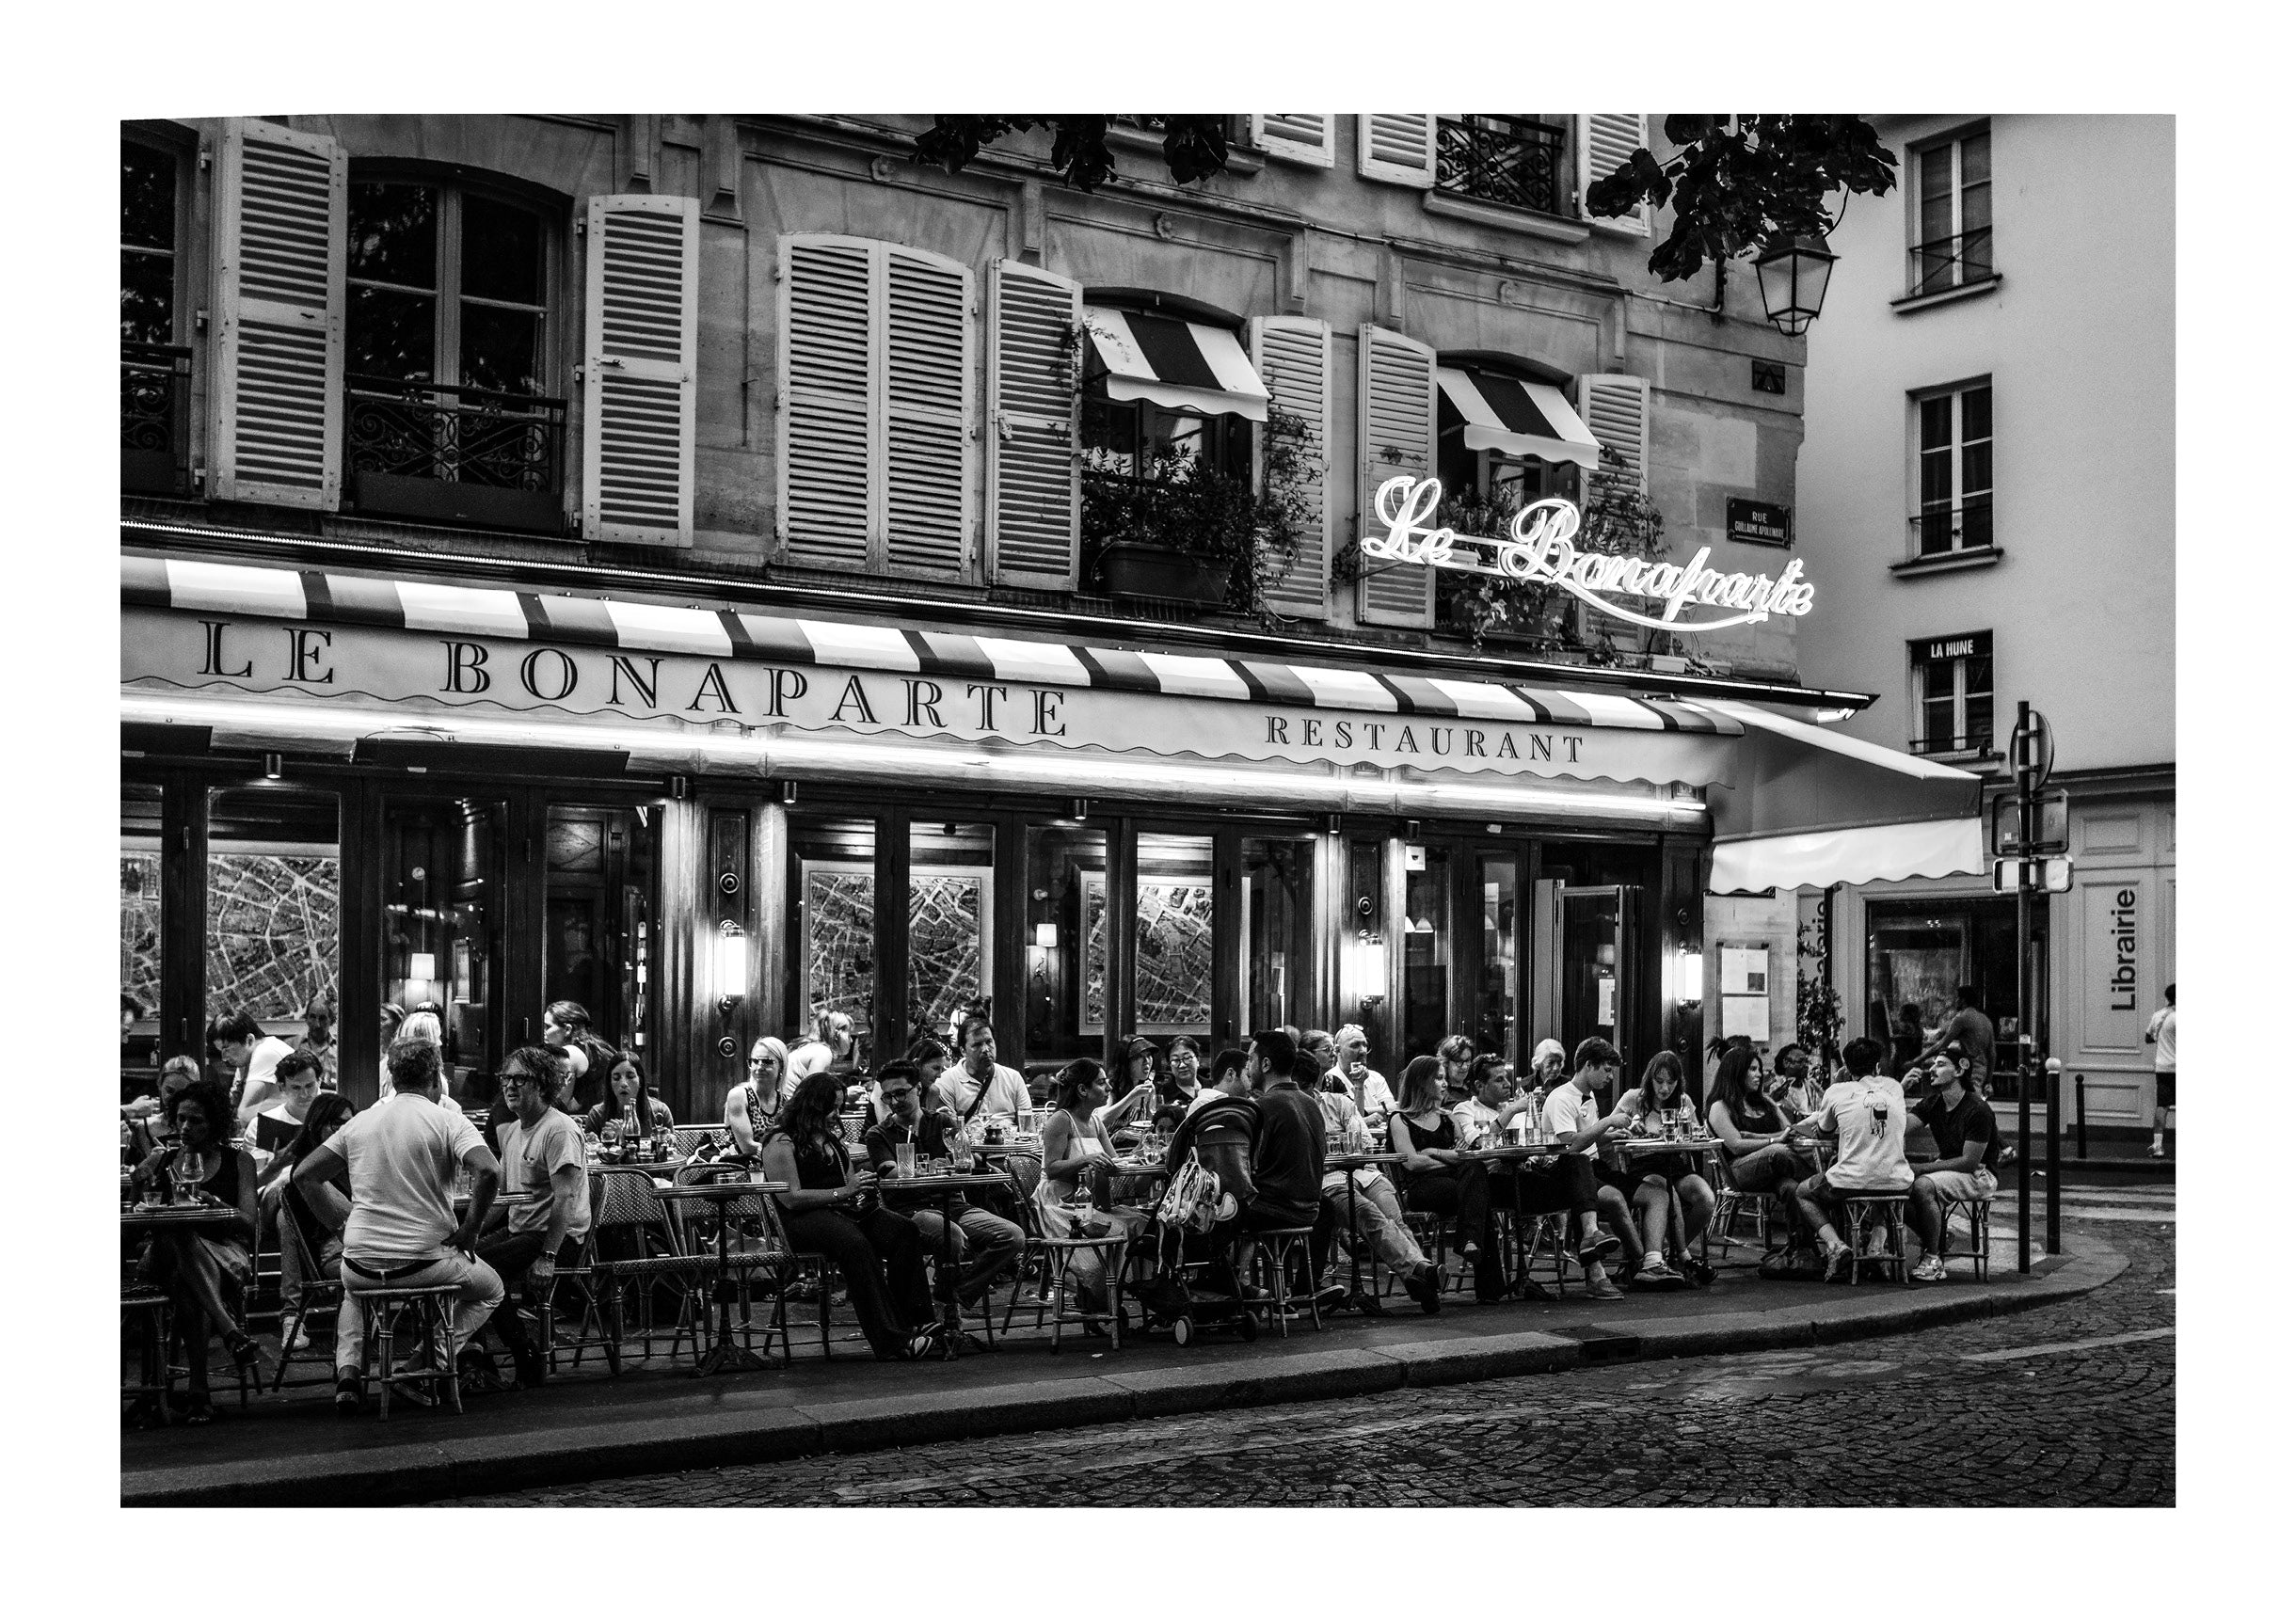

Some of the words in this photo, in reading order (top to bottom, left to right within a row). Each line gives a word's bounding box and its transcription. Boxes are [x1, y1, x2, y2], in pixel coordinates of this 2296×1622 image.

[1361, 475, 1455, 565] Le
[1500, 498, 1815, 631] Bonaparte
[1752, 511, 1767, 524] RUE
[197, 620, 333, 684] LE
[438, 641, 1066, 736] BONAPARTE
[1930, 643, 1943, 659] LA
[1945, 639, 1974, 658] HUNE
[1265, 715, 1584, 764] RESTAURANT
[2111, 888, 2136, 1011] Librairie
